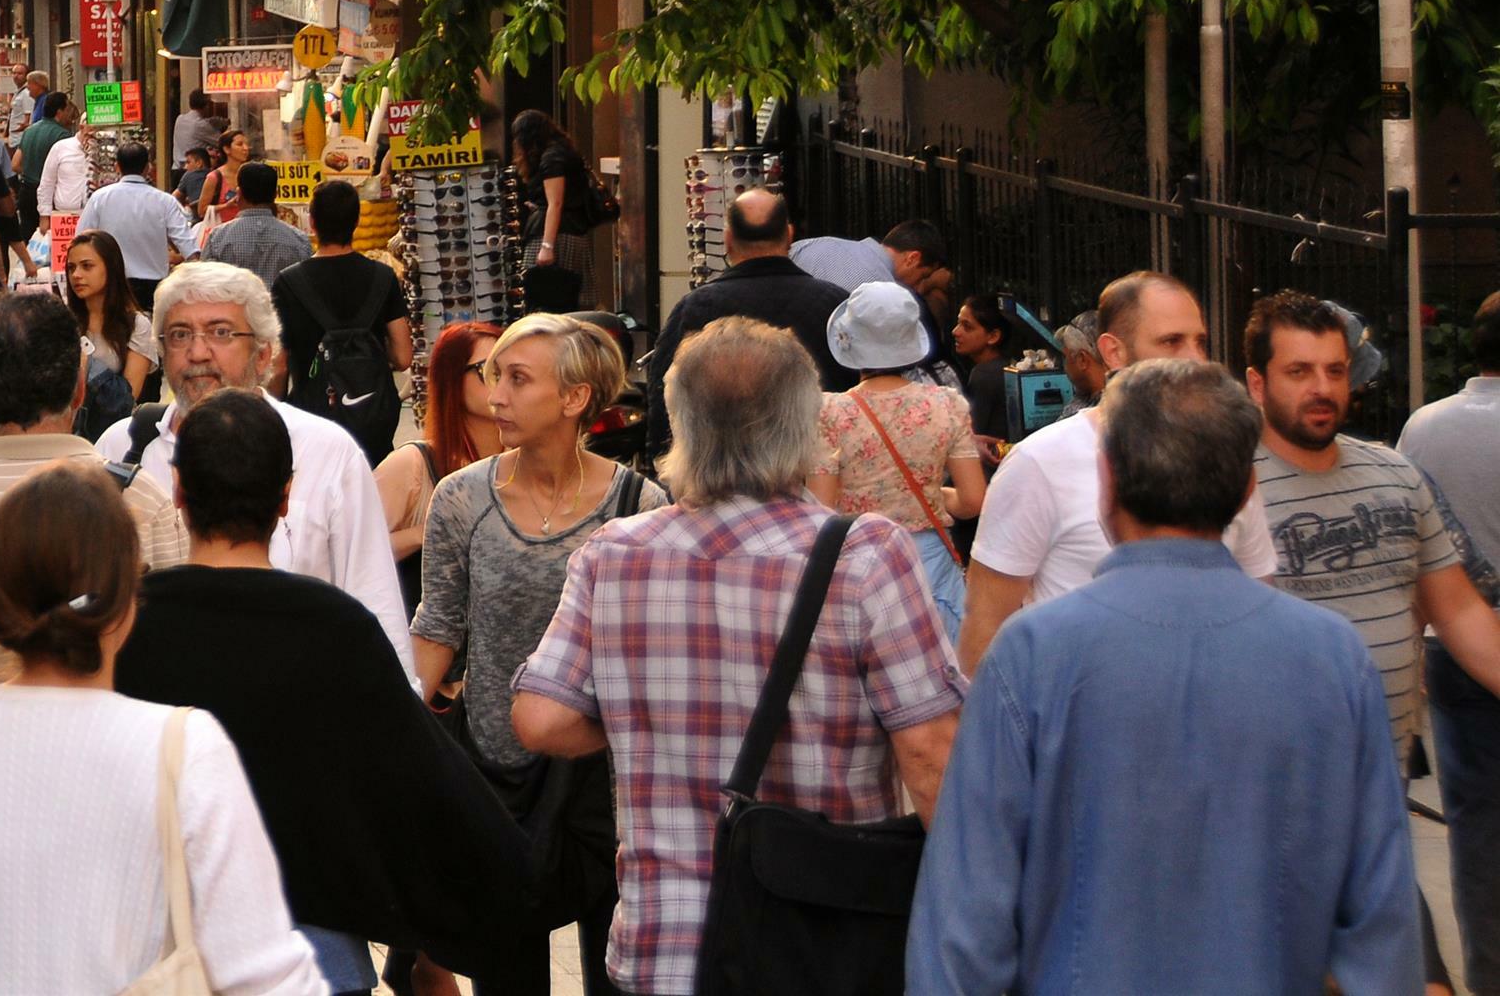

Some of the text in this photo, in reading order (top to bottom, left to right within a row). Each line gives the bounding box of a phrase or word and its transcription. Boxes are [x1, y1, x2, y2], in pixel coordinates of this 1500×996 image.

[208, 72, 242, 89] SAAT
[396, 147, 478, 167] TAMİRİ
[289, 165, 310, 179] SÜT
